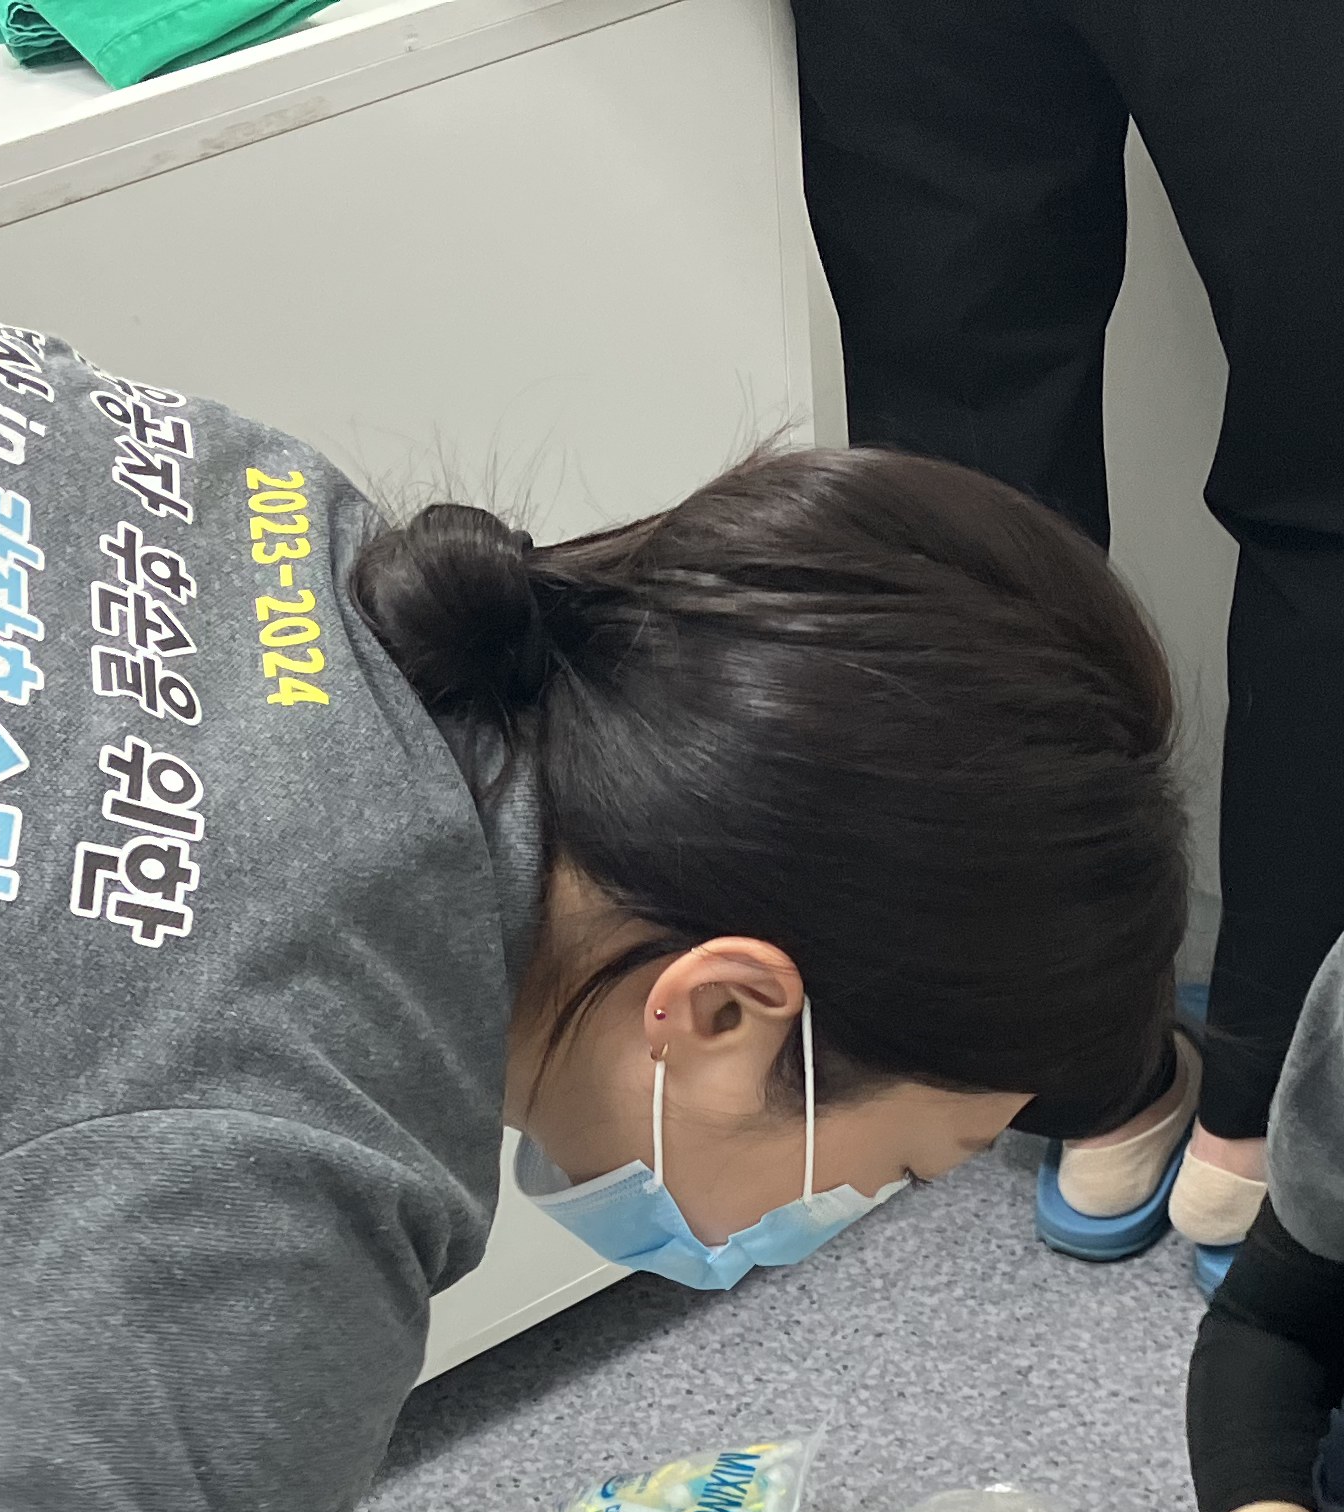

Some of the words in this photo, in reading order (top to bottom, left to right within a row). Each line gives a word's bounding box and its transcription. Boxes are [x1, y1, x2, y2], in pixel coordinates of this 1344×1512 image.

[91, 521, 203, 726] 후손을
[245, 468, 329, 706] 2023-2024
[69, 735, 205, 949] 위한
